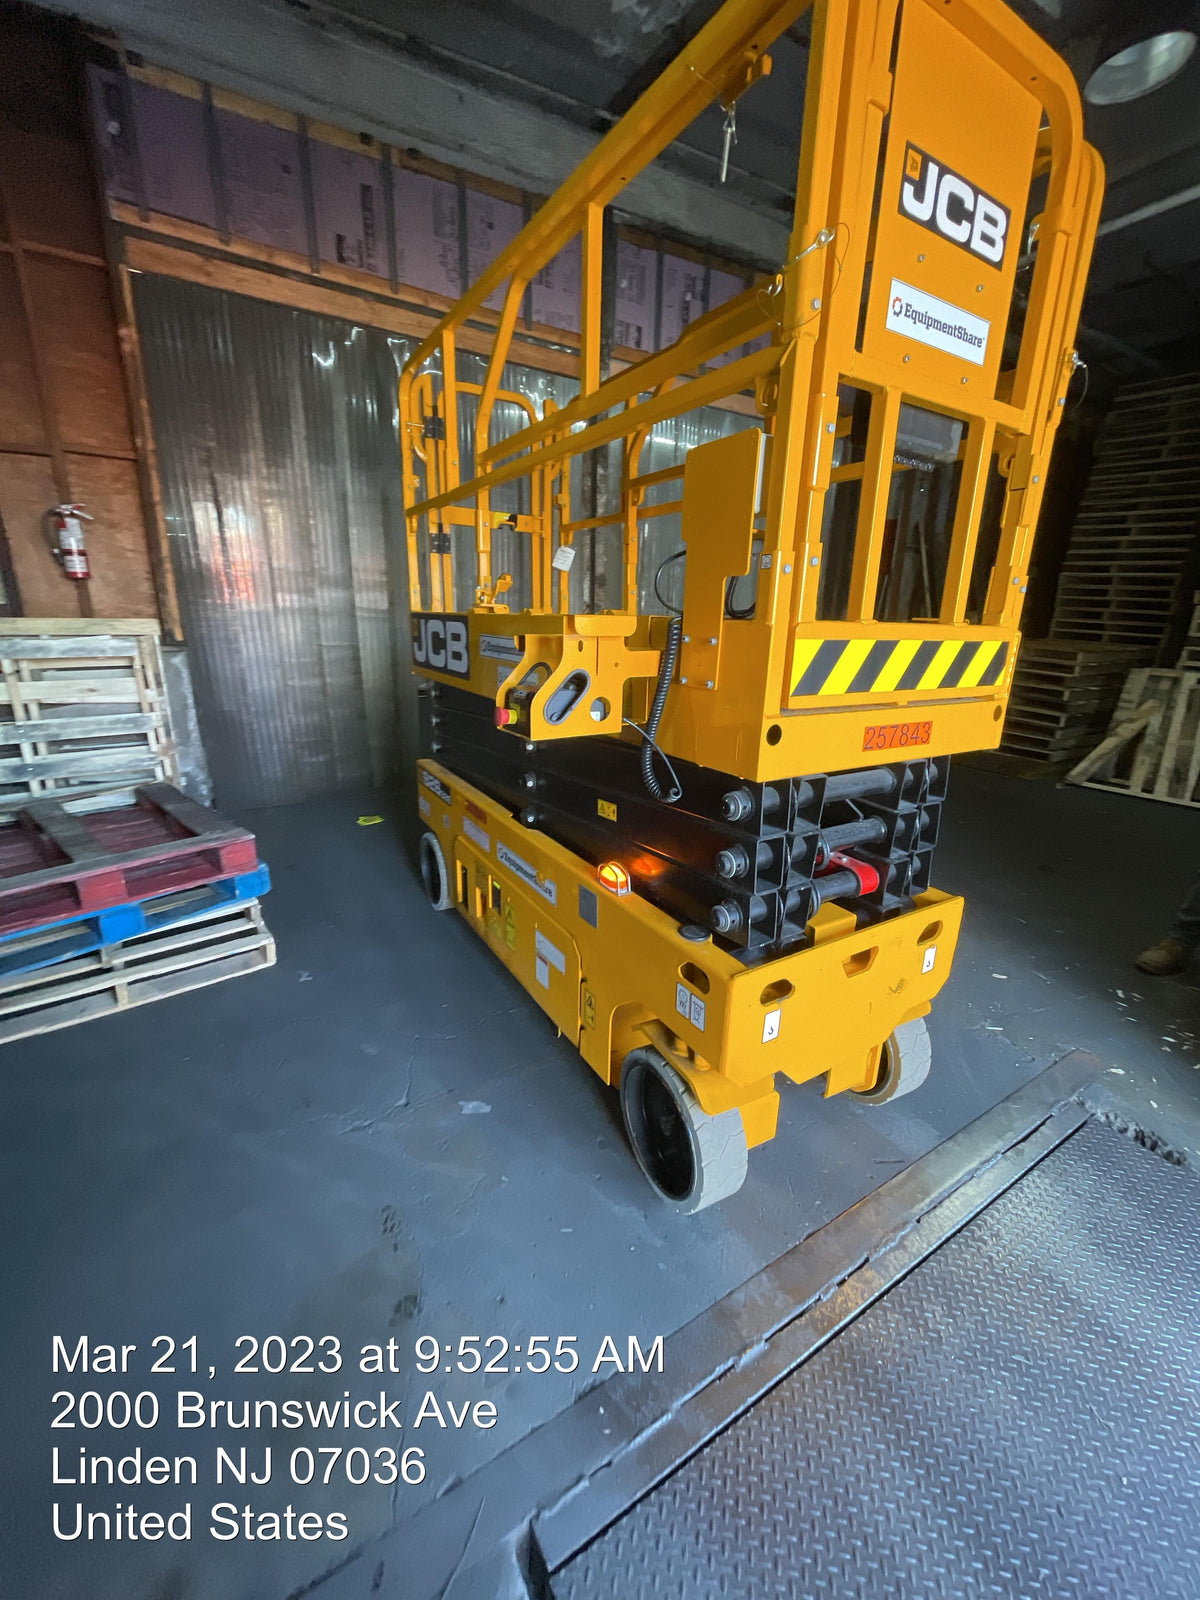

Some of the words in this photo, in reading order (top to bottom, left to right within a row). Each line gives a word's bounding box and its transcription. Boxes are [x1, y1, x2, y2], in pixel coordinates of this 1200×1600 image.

[902, 161, 1007, 263] JCB
[903, 302, 984, 348] EquipmentShare
[413, 619, 469, 674] JCB
[864, 721, 931, 750] 257843
